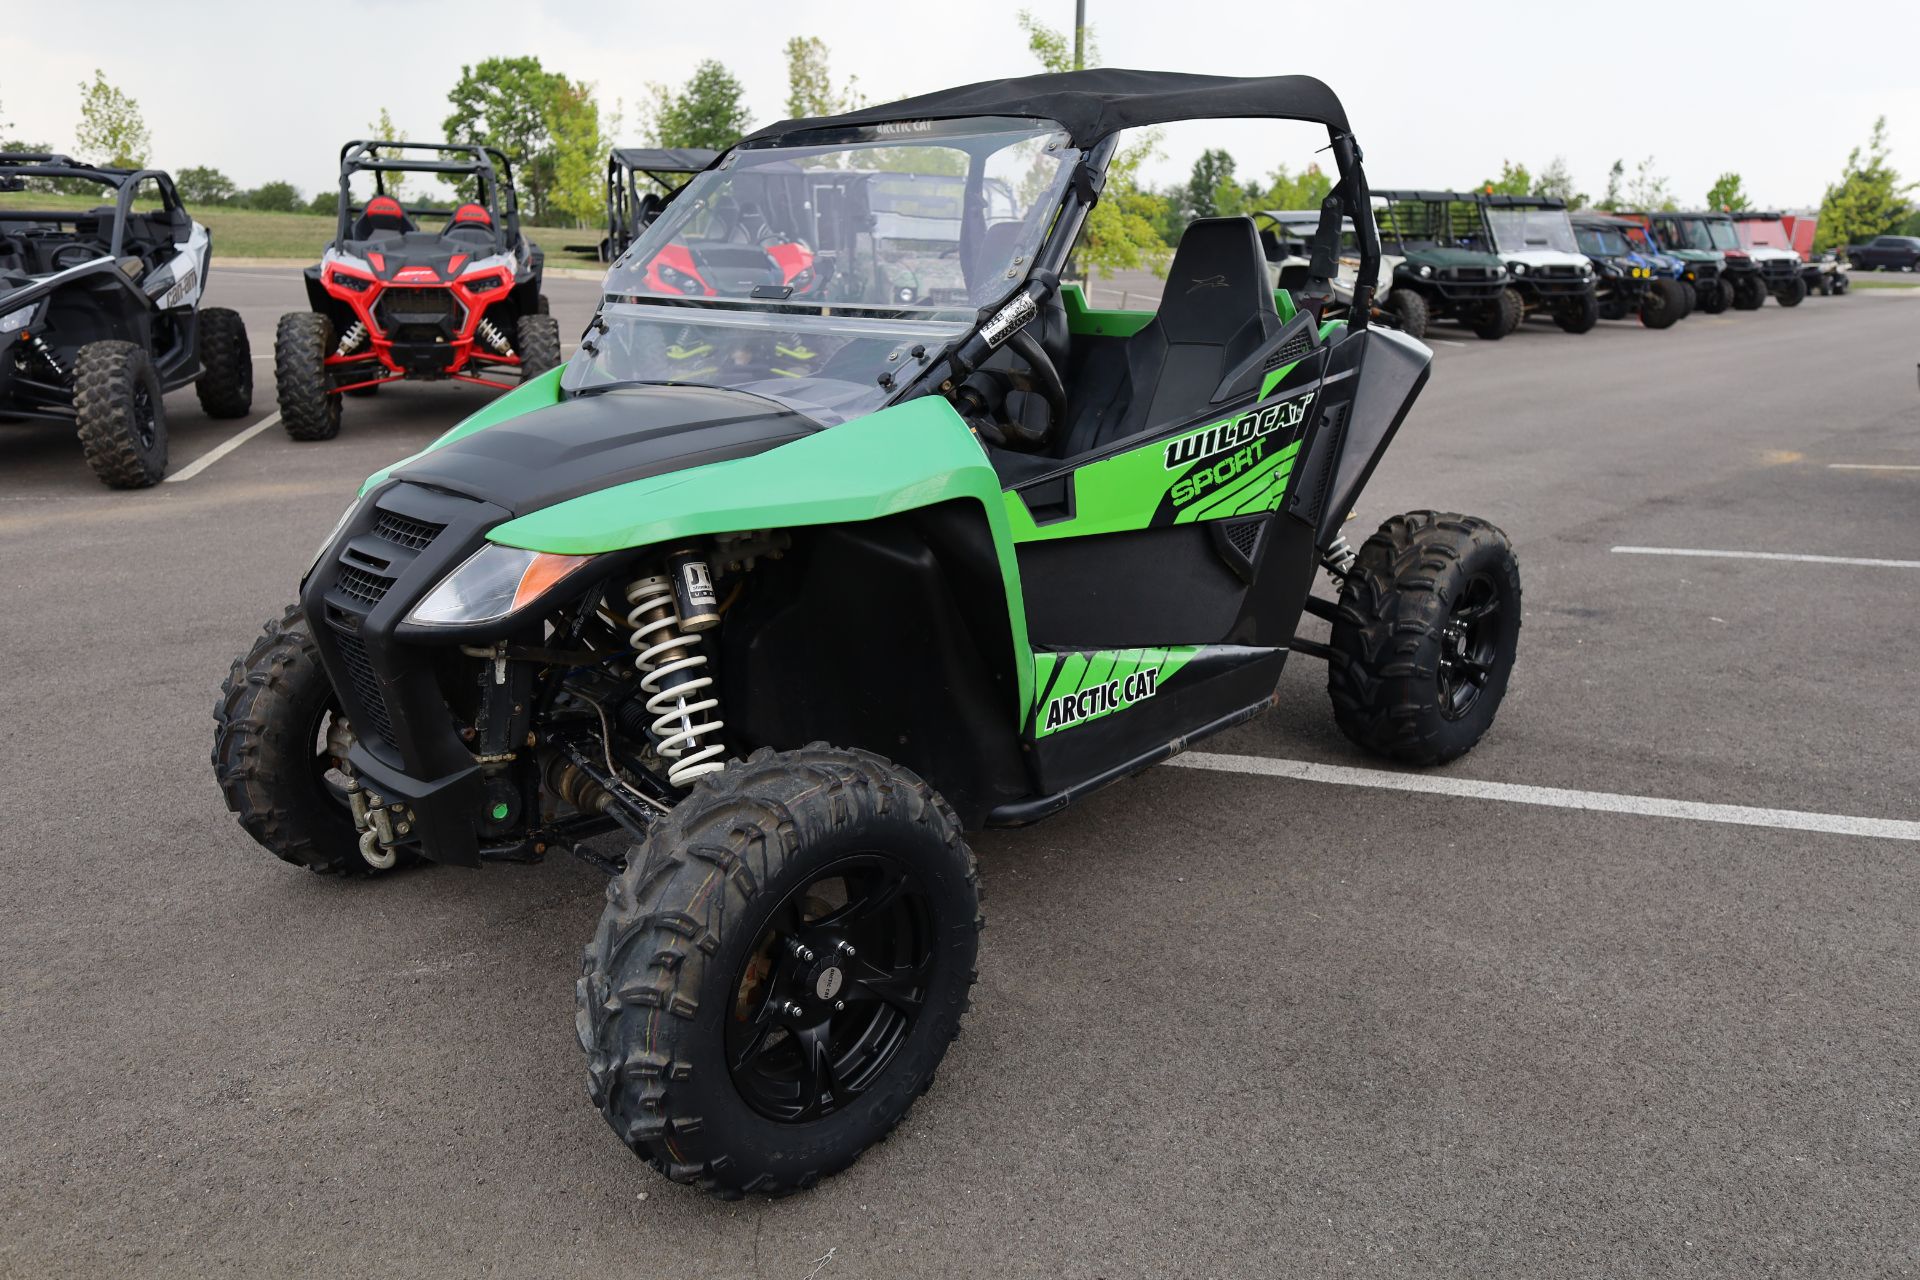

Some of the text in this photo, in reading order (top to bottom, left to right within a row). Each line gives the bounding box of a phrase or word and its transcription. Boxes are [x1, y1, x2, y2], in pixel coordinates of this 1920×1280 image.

[913, 120, 931, 131] CAT
[1164, 392, 1314, 471] WILDCAT
[1171, 437, 1267, 507] SPORT
[1044, 667, 1159, 732] ARCTIC CAT
